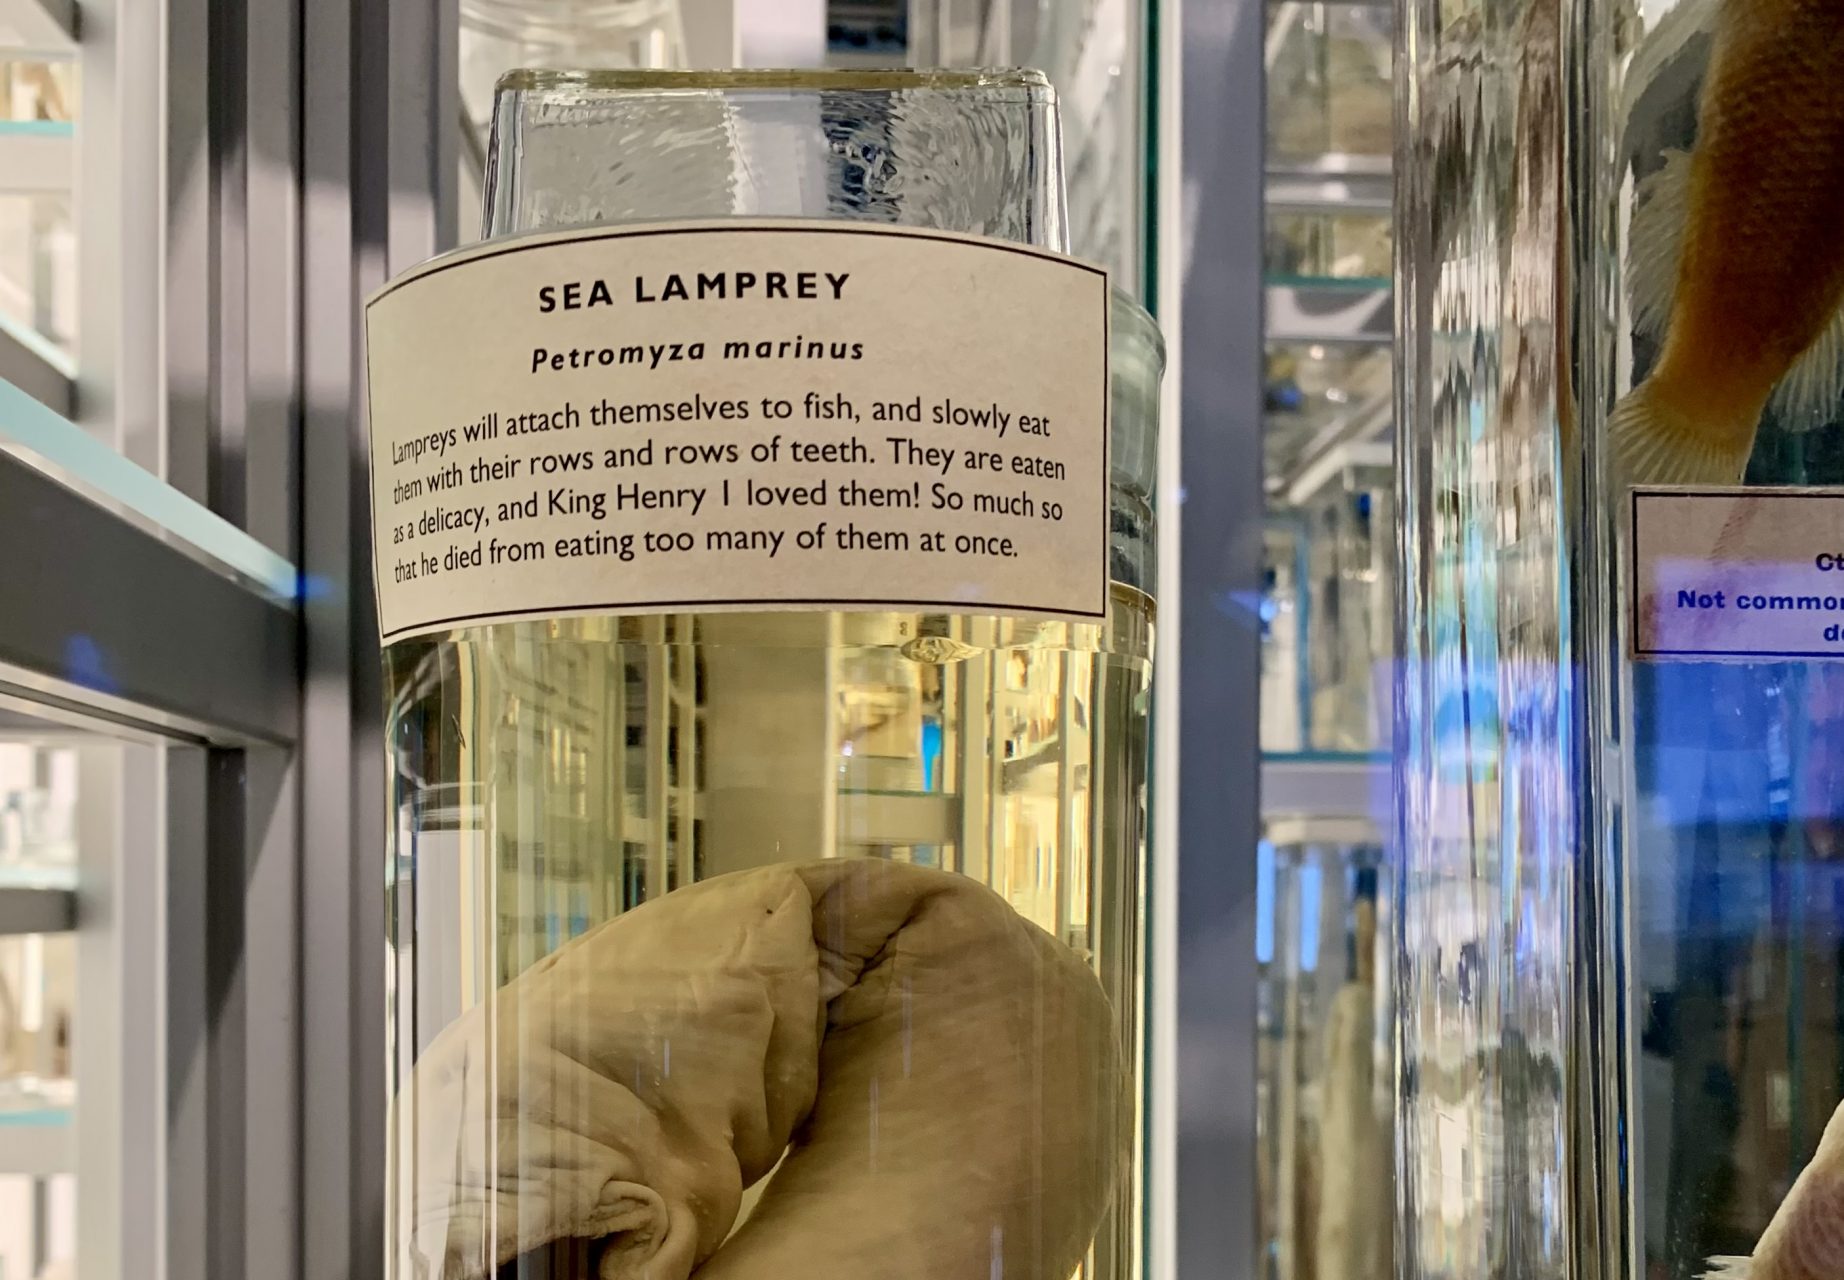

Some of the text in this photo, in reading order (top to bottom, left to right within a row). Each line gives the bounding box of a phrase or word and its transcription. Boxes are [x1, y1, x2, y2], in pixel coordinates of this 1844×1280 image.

[539, 271, 850, 314] SEA LAMPREY
[531, 334, 864, 374] Petromyza marinus
[392, 391, 1051, 466] Lampreys will attach themselves to fish, and slowly eat
[393, 434, 1065, 505] them with their rows and rows of teeth. They are eaten
[393, 478, 1063, 545] as a delicacy, and King Henry I loved them! So much so
[394, 521, 1018, 584] that he died from eating too many of them at once.
[1815, 552, 1844, 571] Ct
[1677, 589, 1844, 610] Not commo
[1823, 624, 1844, 641] d
